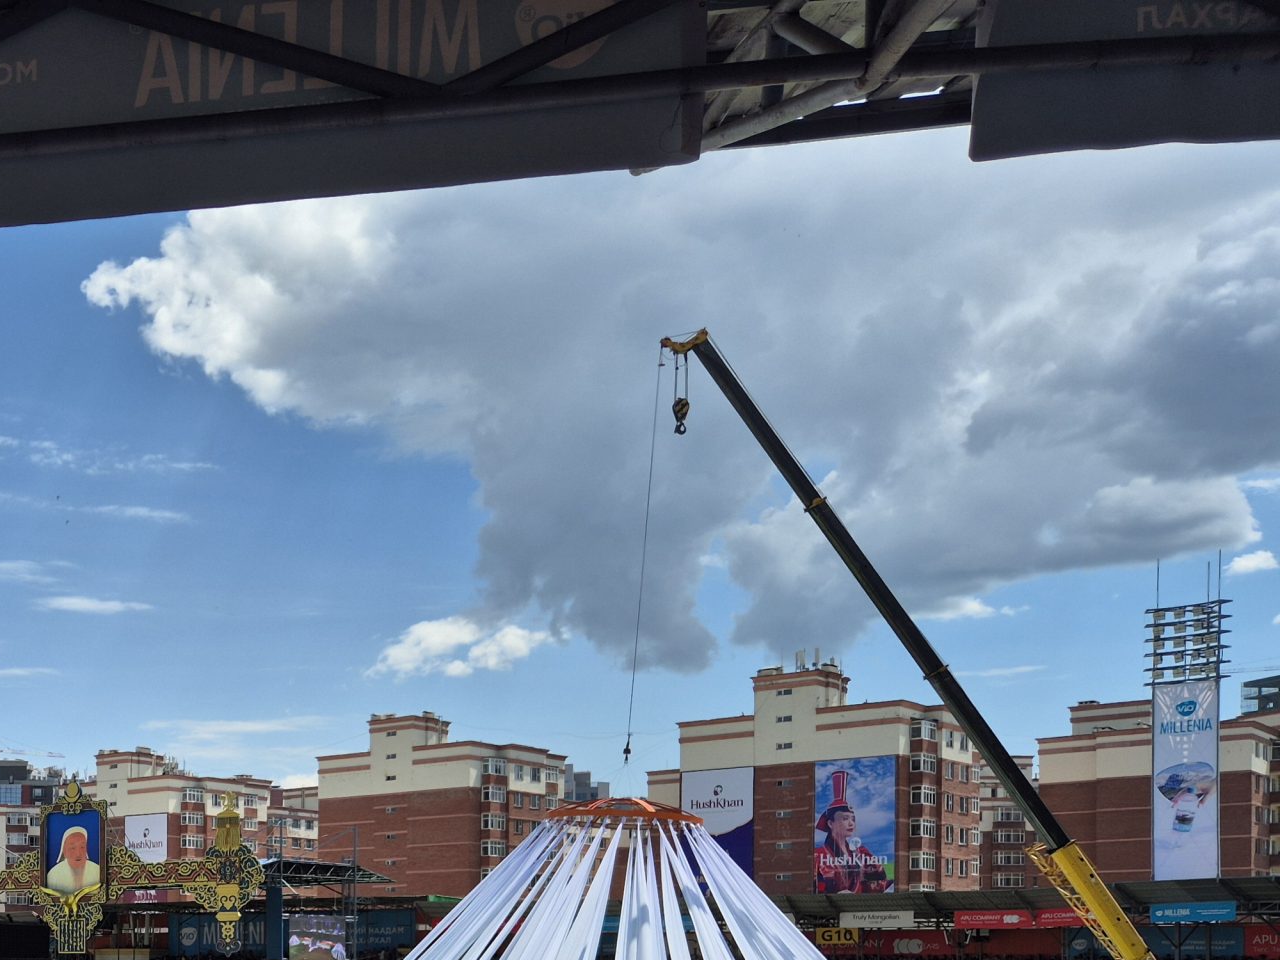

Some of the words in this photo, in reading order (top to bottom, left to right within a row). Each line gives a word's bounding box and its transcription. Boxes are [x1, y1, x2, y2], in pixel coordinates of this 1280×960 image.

[1159, 718, 1213, 734] MILLENIA
[691, 796, 744, 810] HushKhan
[820, 852, 888, 866] HushKhan
[821, 929, 854, 942] G10
[1252, 934, 1278, 945] APU
